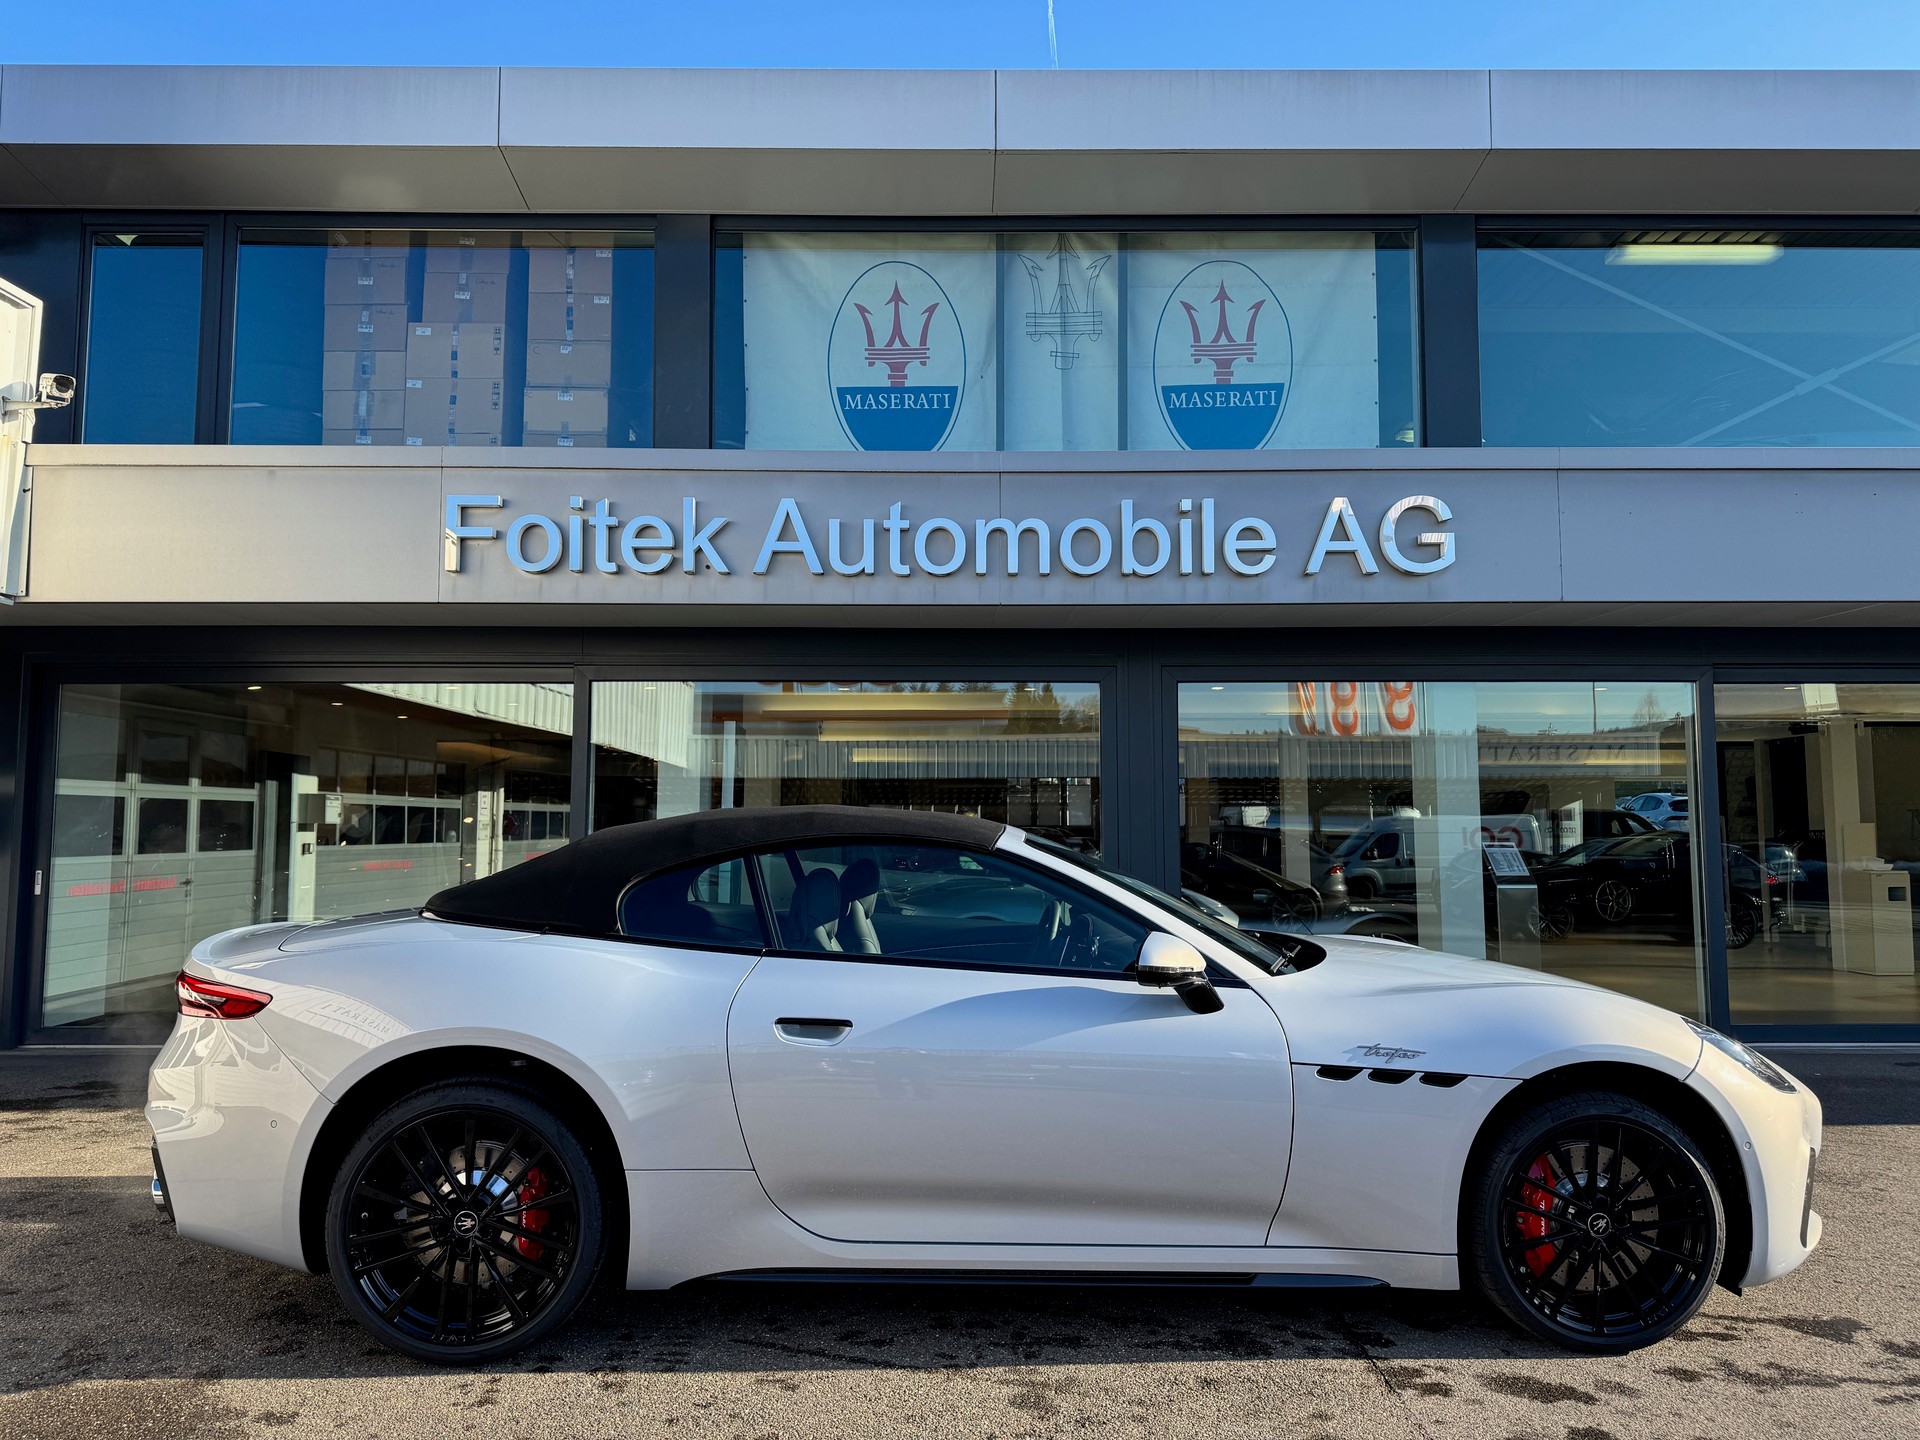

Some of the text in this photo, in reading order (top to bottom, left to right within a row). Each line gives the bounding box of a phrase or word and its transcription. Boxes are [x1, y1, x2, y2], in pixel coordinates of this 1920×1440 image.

[843, 392, 952, 411] MASERATI
[1168, 389, 1277, 410] MASERATI
[443, 494, 1456, 577] Foitek Automobile AG
